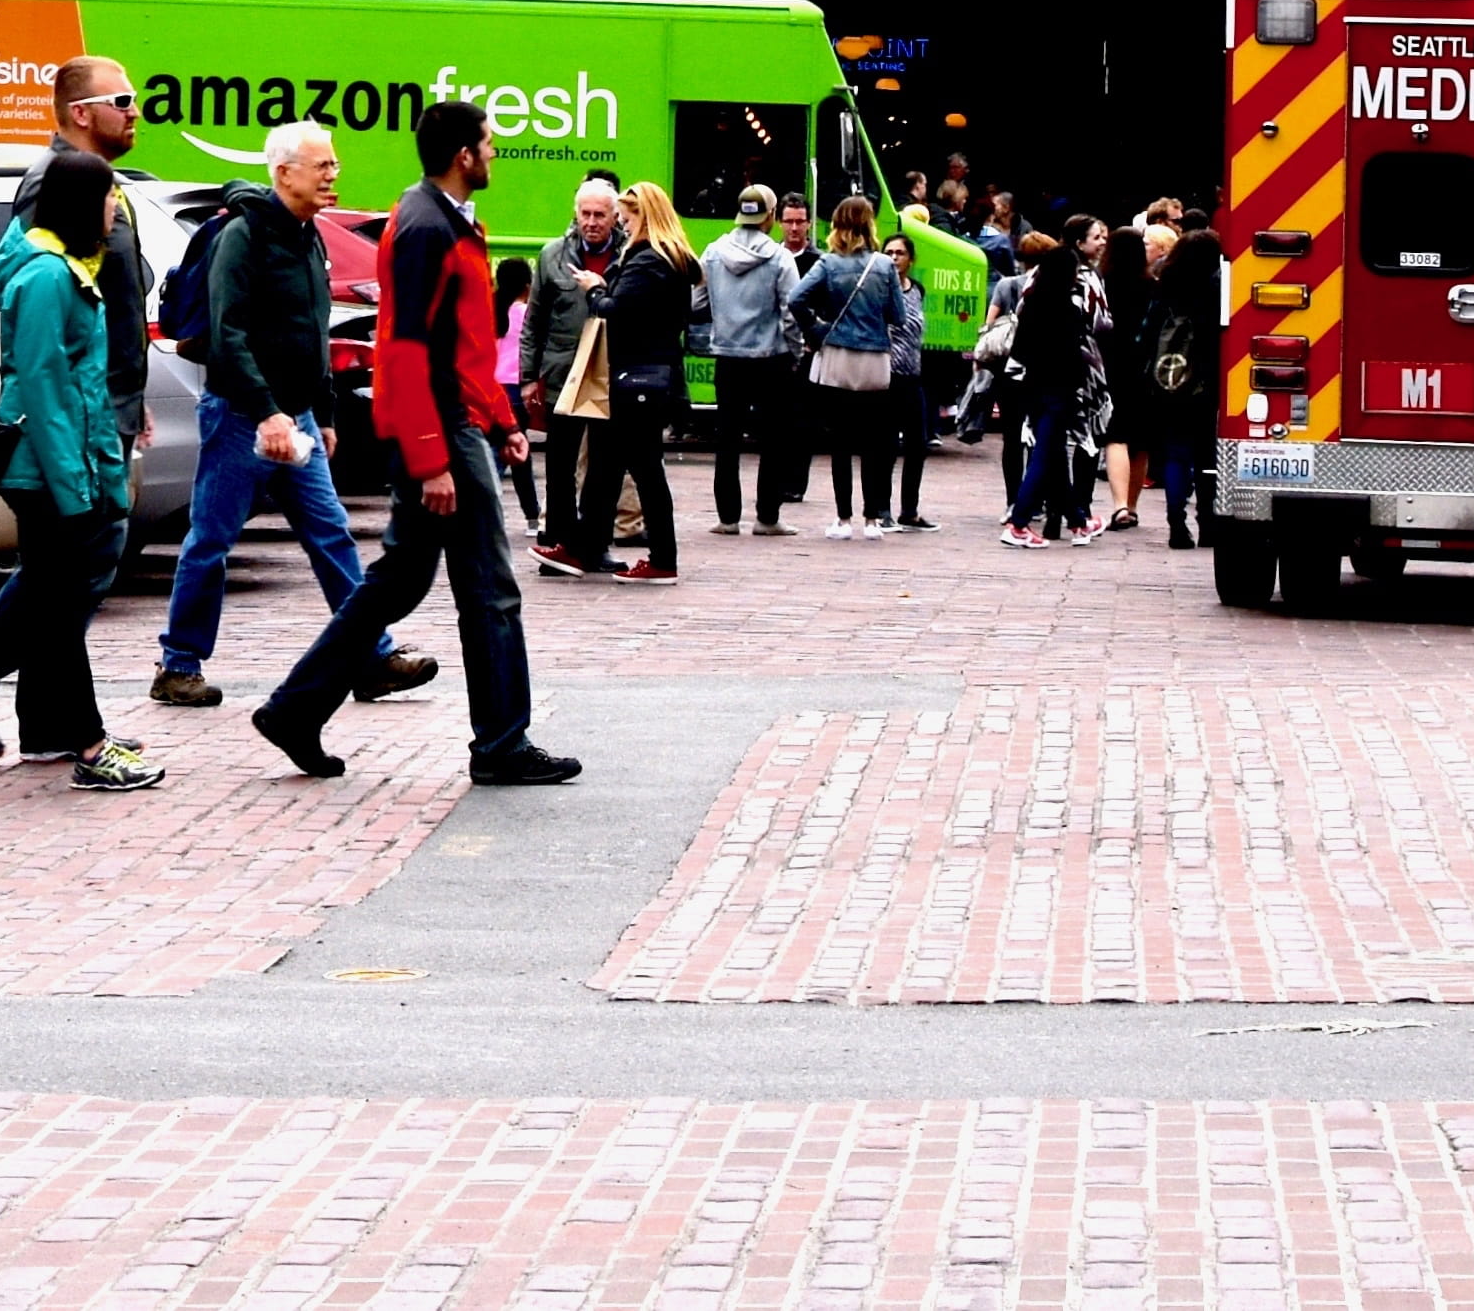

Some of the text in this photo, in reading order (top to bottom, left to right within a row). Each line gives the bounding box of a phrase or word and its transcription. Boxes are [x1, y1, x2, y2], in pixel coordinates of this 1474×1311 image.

[1, 93, 16, 105] of
[1400, 252, 1441, 267] 33082
[933, 268, 960, 292] TOYS
[1401, 368, 1442, 409] M1
